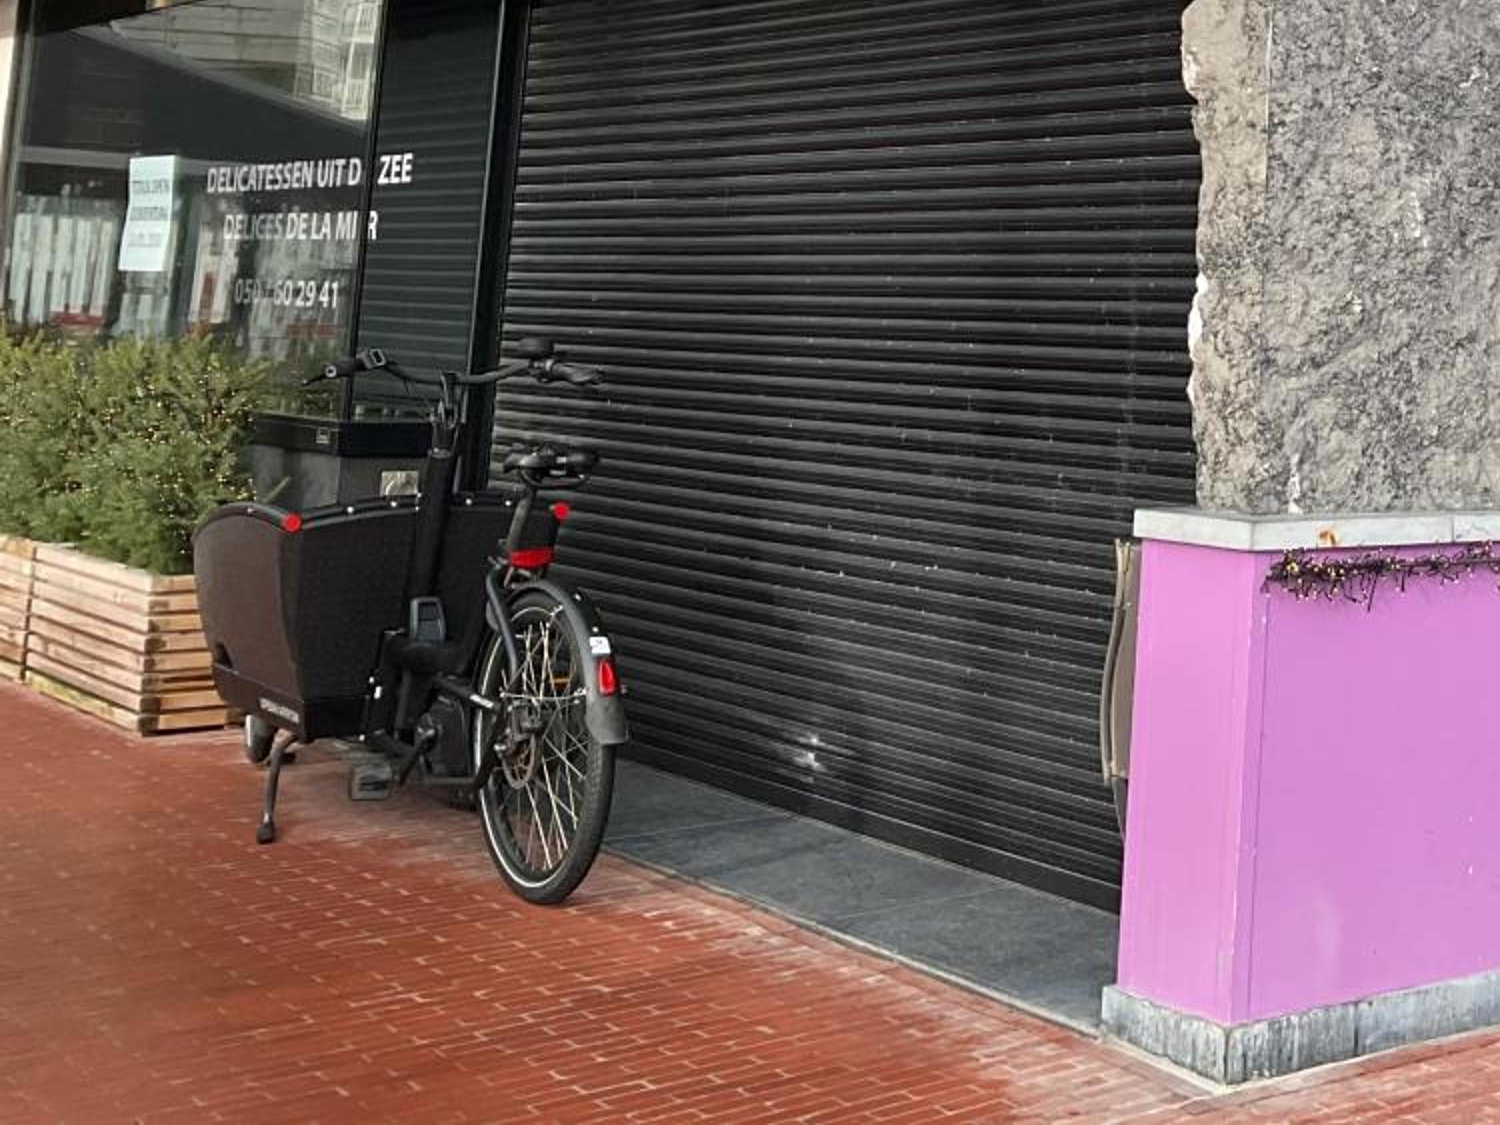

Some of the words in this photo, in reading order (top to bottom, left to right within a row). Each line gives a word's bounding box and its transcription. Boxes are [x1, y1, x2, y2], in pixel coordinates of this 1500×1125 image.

[206, 159, 314, 194] DELICATESSEN
[316, 158, 347, 188] UIT
[377, 152, 414, 185] ZEE
[223, 212, 285, 241] DELICES
[285, 211, 309, 241] DE
[309, 211, 332, 241] LA
[294, 279, 317, 308] 29
[318, 280, 340, 309] 41
